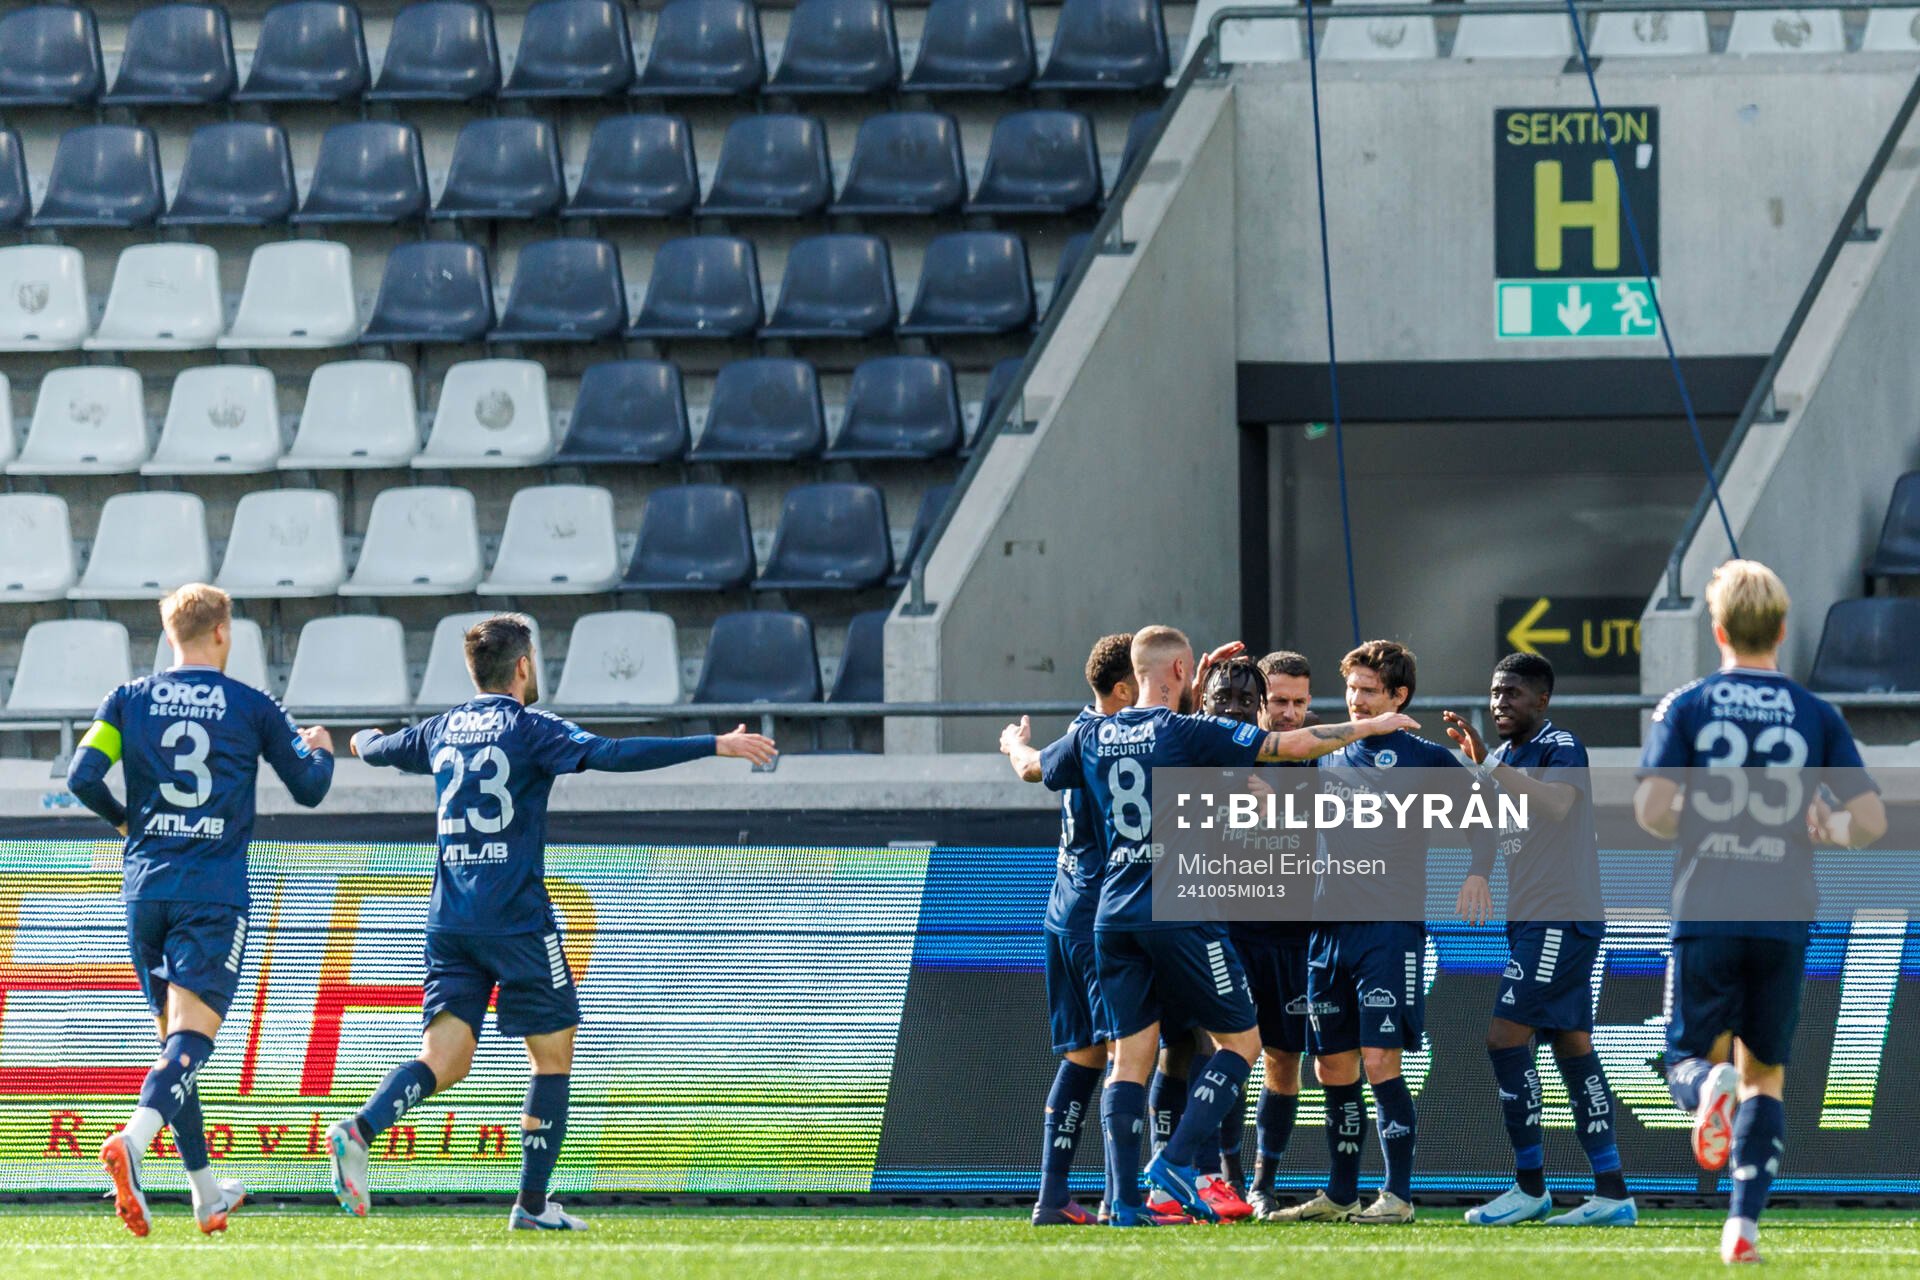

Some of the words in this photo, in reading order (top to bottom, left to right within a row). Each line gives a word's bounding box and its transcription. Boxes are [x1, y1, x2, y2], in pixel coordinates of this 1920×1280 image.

[1507, 112, 1648, 146] SEKTION
[1535, 159, 1620, 271] H
[151, 682, 227, 708] ORCA
[1712, 681, 1796, 713] ORCA
[149, 703, 226, 721] SECURITY
[448, 710, 505, 732] ORCA
[1711, 703, 1797, 725] SECURITY
[444, 730, 501, 745] SECURITY
[1099, 720, 1156, 746] ORCA
[1097, 741, 1157, 757] SECURITY
[159, 719, 213, 809] 3
[1690, 719, 1809, 826] 33
[432, 745, 515, 835] 23
[1107, 756, 1152, 841] 8
[1243, 831, 1300, 850] Finans
[1583, 1074, 1610, 1118] Enviro
